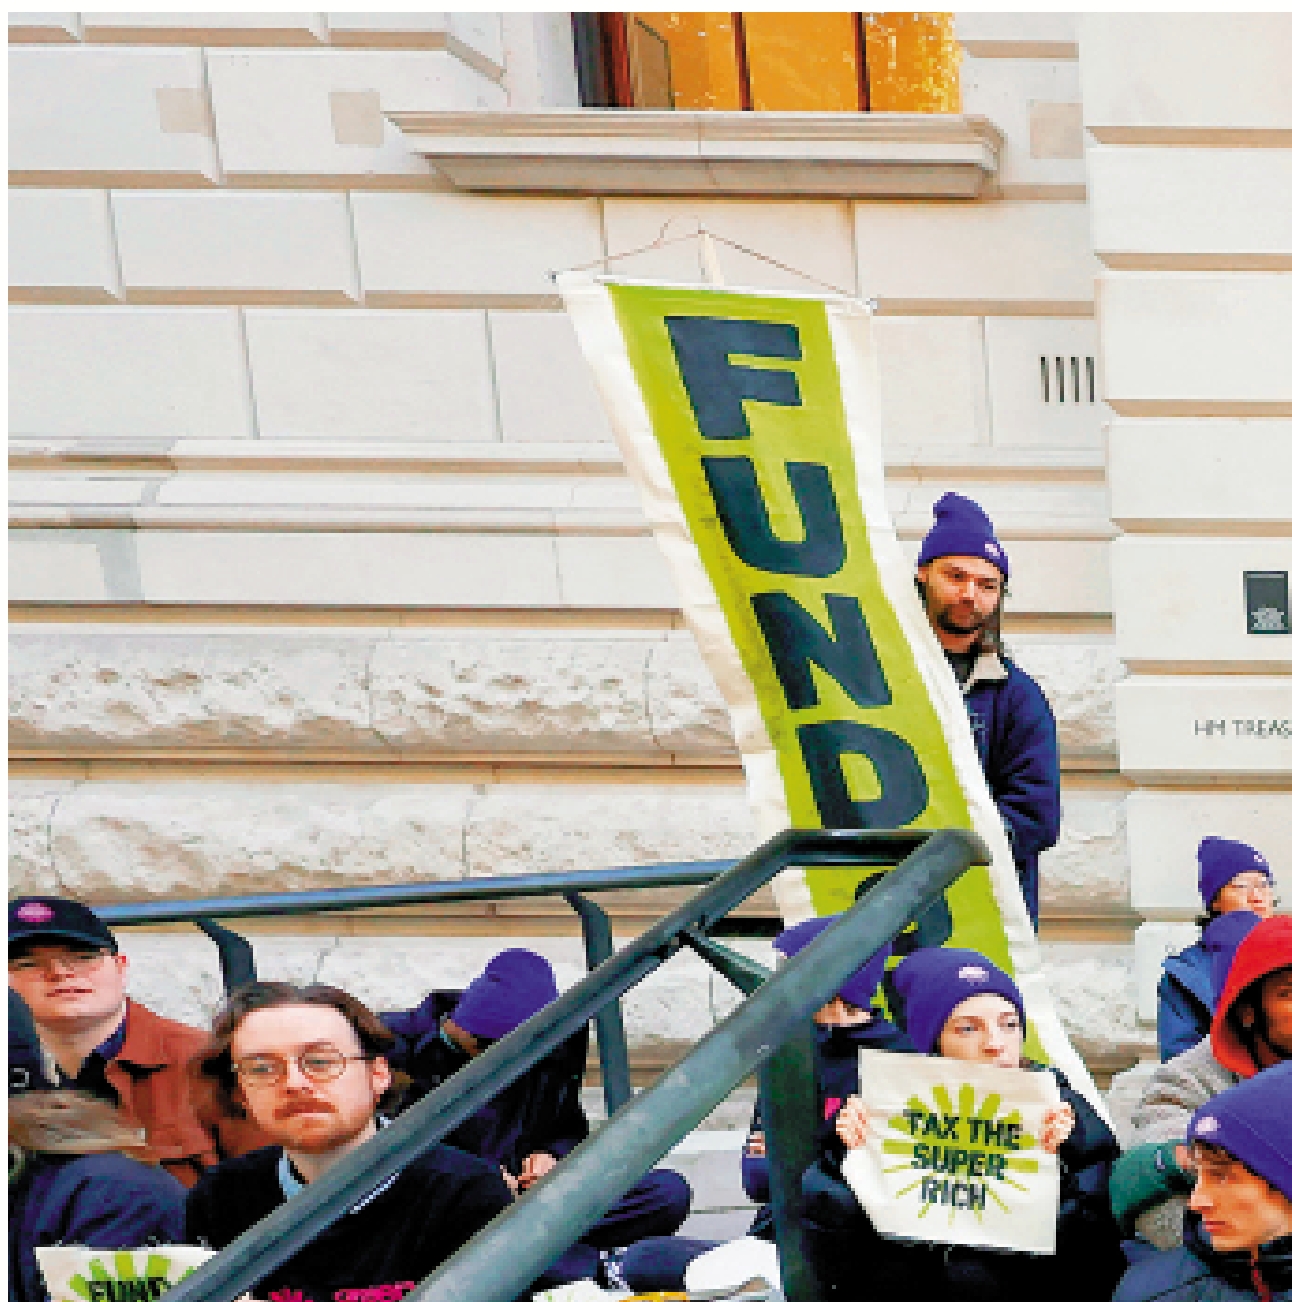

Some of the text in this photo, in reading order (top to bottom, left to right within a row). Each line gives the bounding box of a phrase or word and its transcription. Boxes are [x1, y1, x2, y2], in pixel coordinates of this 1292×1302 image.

[664, 315, 929, 832] FUND
[1194, 719, 1226, 736] HM
[903, 1109, 1023, 1151] TAX THE
[911, 1143, 1008, 1181] SUPER
[919, 1175, 986, 1210] RICH
